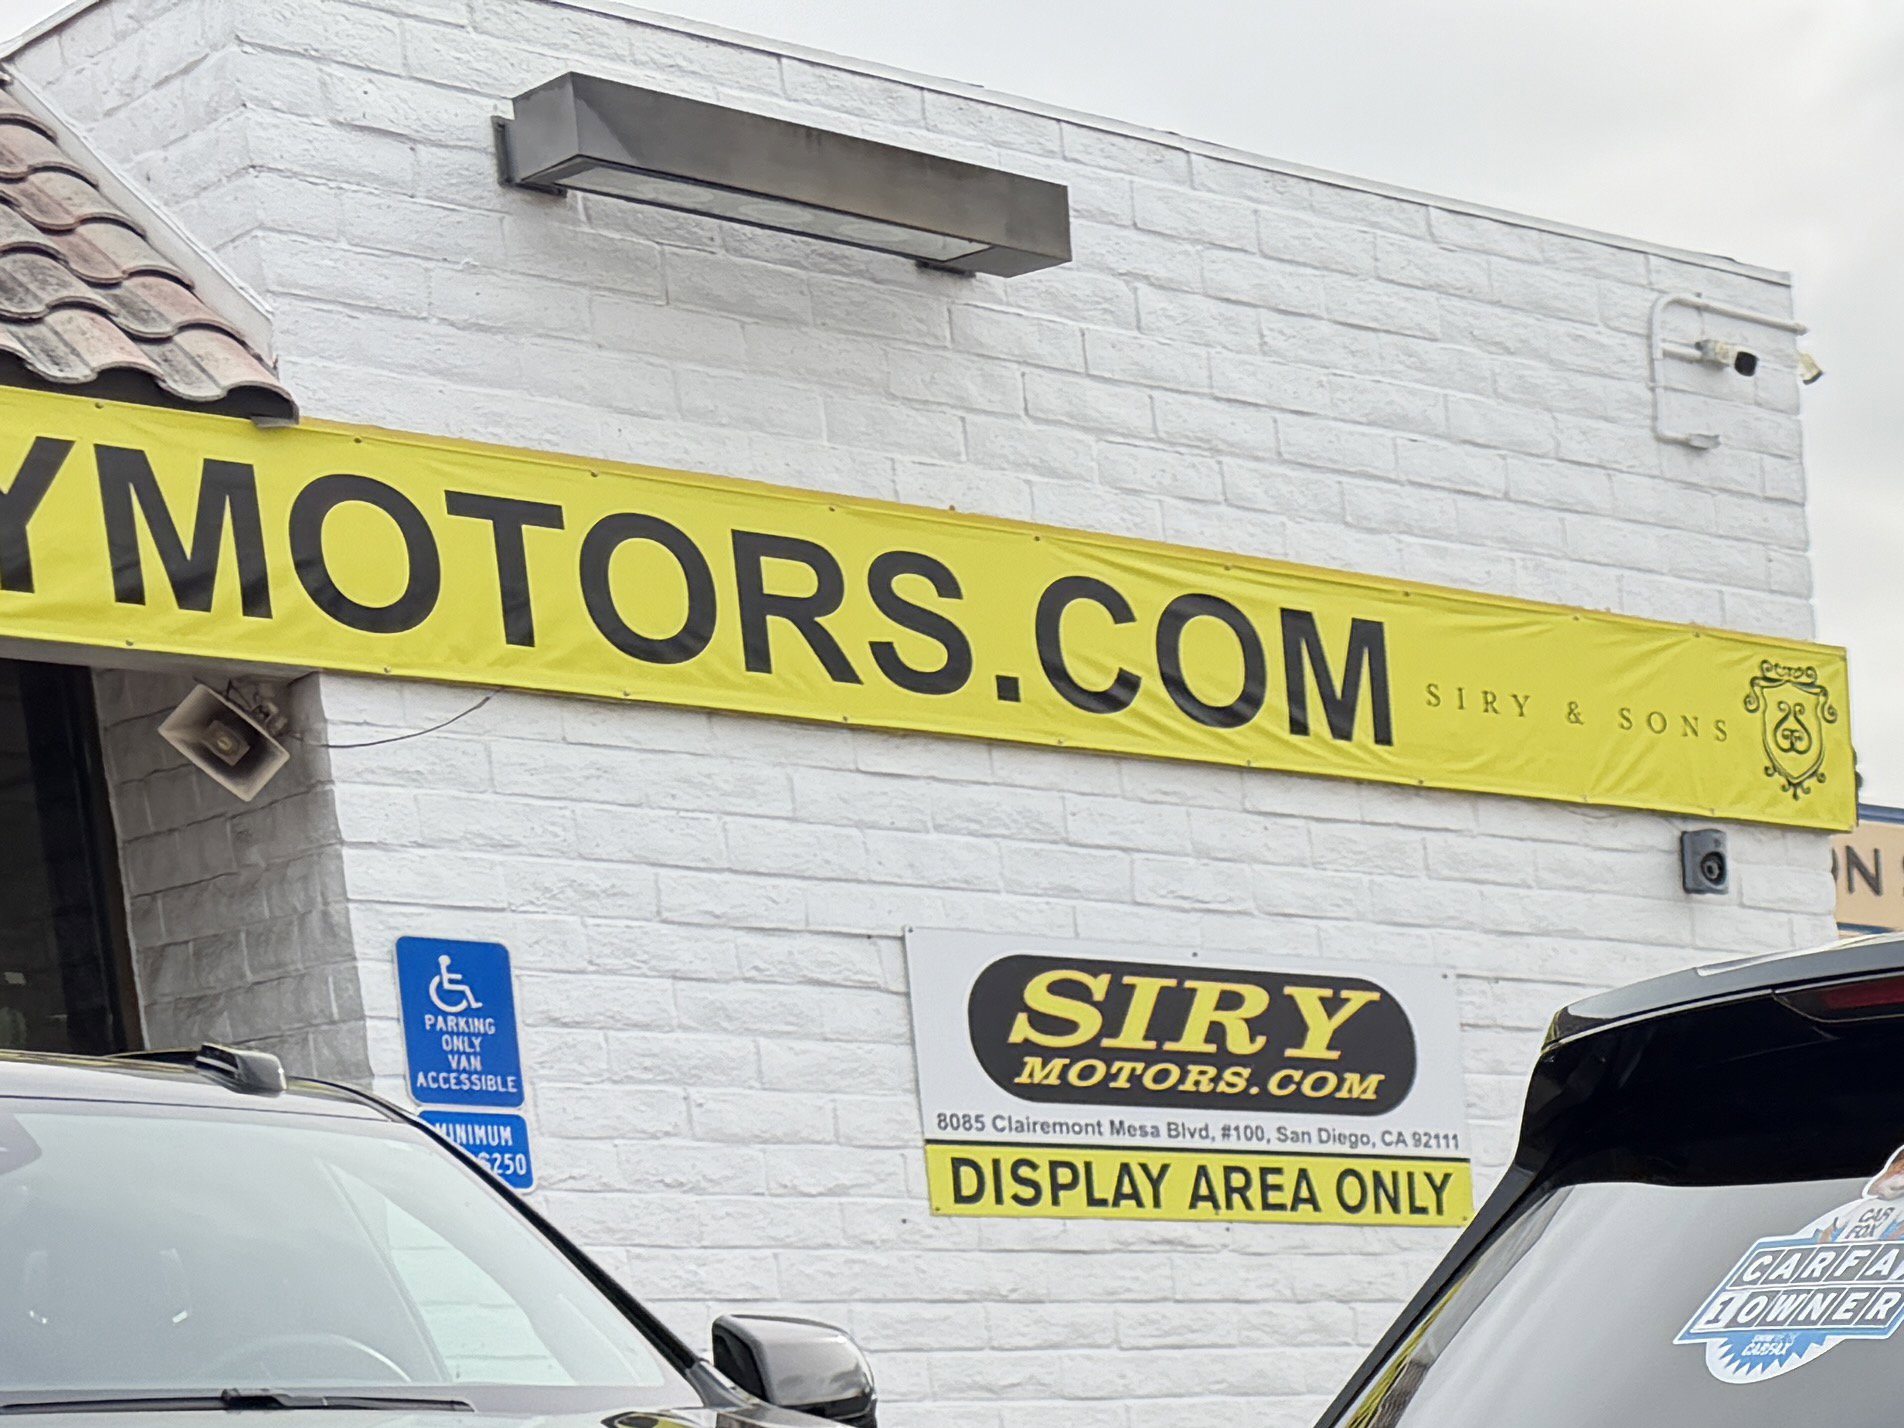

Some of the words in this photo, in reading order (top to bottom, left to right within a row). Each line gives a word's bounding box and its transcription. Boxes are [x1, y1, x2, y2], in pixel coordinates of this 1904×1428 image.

[1426, 683, 1530, 718] SIRY
[1566, 701, 1585, 726] &
[1619, 707, 1728, 743] SONS
[424, 1014, 496, 1035] PARKING
[1007, 969, 1381, 1060] SIRY
[441, 1035, 482, 1052] ONLY
[448, 1054, 482, 1071] VAN
[1014, 1056, 1386, 1100] MOTORS.COM
[417, 1072, 518, 1093] ACCESSIBLE
[937, 1112, 986, 1132] 8085
[992, 1114, 1103, 1136] Clairemont
[1109, 1119, 1160, 1138] Mesa
[1167, 1120, 1215, 1142] Blvd,
[1221, 1124, 1271, 1145] #100,
[1276, 1126, 1312, 1144] San
[1318, 1128, 1376, 1150] Diego,
[1381, 1130, 1409, 1147] CA
[1412, 1131, 1460, 1150] 92111
[951, 1157, 1171, 1209] DISPLAY
[1189, 1165, 1322, 1213] AREA
[1336, 1168, 1454, 1216] ONLY
[1737, 1291, 1902, 1323] OWNER
